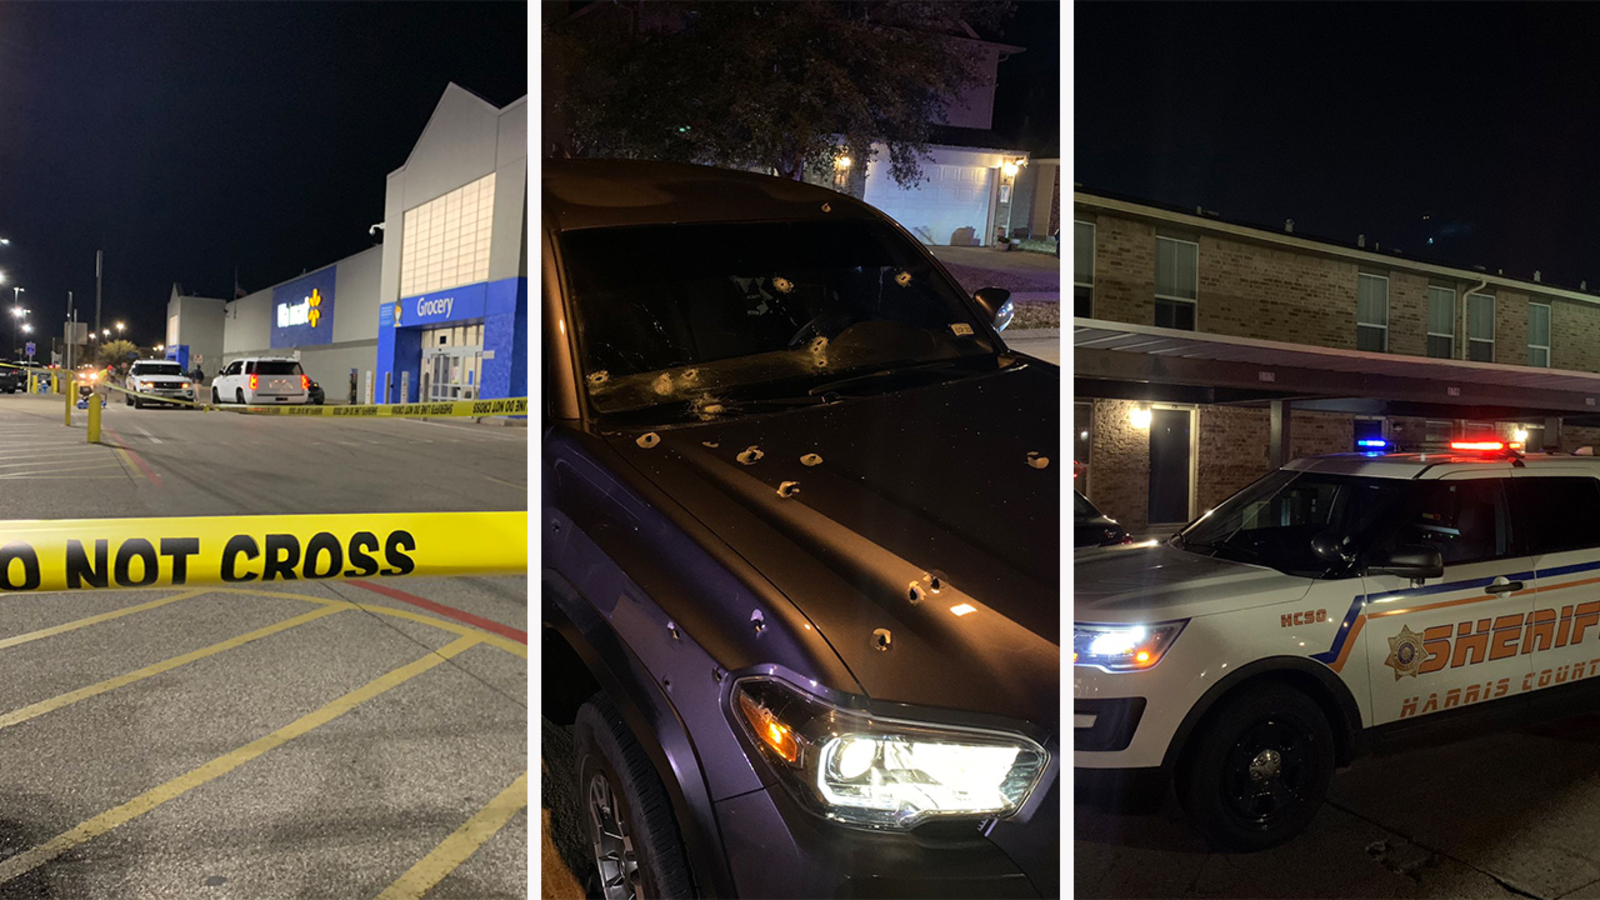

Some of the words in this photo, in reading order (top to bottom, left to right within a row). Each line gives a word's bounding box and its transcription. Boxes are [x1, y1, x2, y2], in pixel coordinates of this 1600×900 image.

[417, 297, 454, 319] Grocery
[66, 537, 199, 590] NOT
[220, 530, 416, 583] CROSS
[1281, 608, 1327, 628] HCSO
[1417, 601, 1600, 675] SHERIF
[1400, 677, 1510, 718] HARRIS
